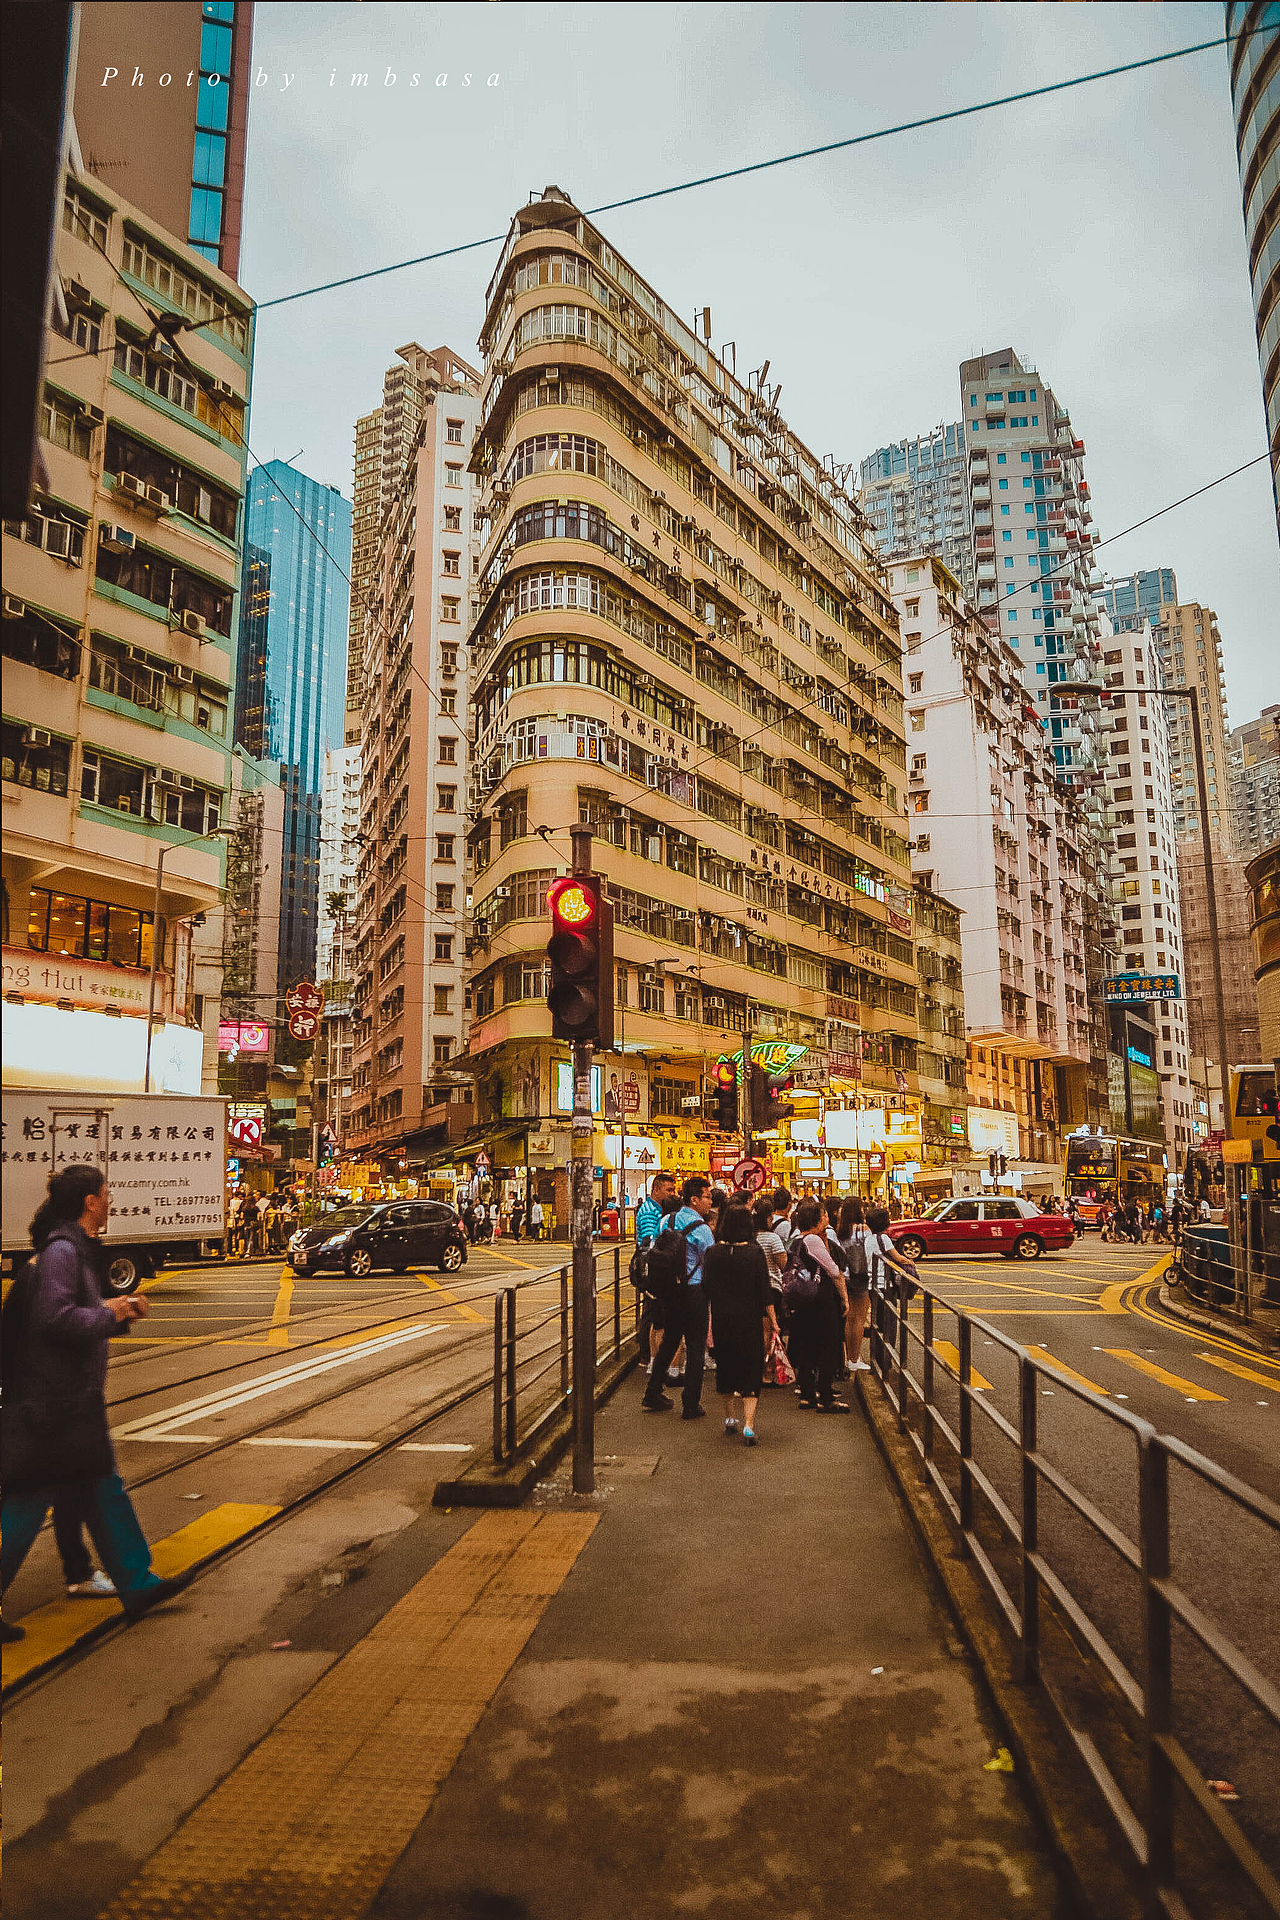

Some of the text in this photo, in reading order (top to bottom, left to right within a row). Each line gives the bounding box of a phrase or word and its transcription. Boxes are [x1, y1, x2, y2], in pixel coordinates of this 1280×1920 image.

[41, 968, 84, 992] Hut
[1123, 992, 1132, 1000] ON
[1096, 1165, 1108, 1175] 97
